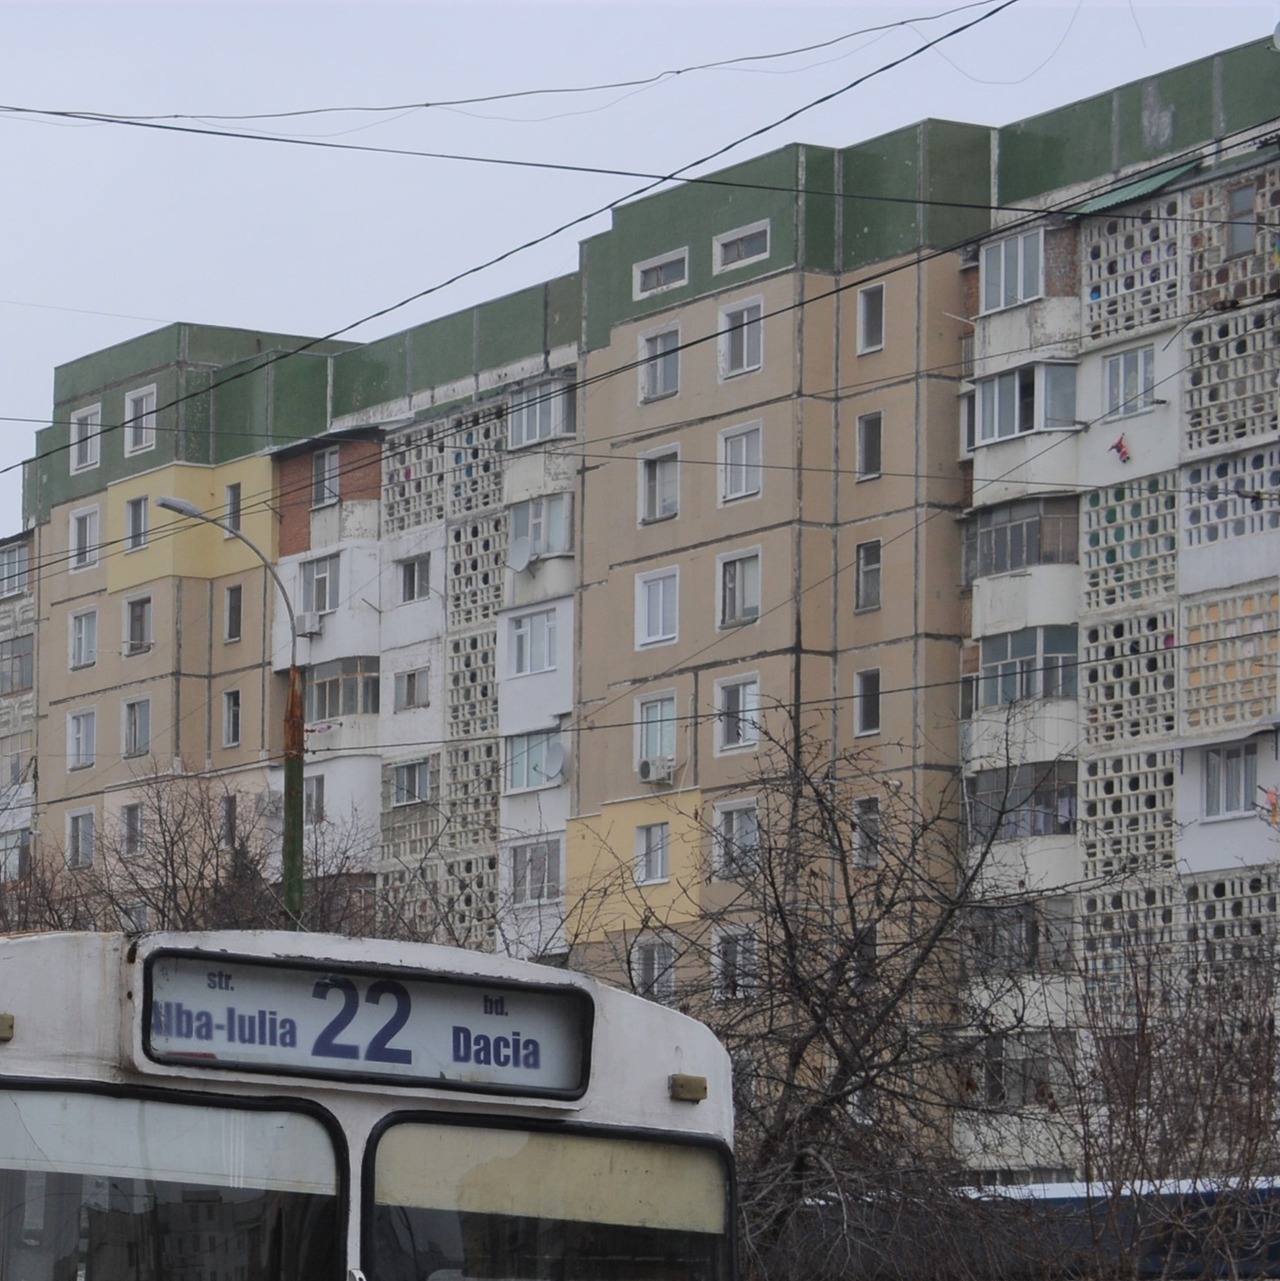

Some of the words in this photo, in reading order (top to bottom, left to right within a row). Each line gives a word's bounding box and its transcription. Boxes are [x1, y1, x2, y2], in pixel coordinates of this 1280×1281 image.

[207, 970, 235, 992] str.
[311, 974, 413, 1066] 22
[482, 994, 509, 1016] bd.
[451, 1025, 541, 1070] Dacia
